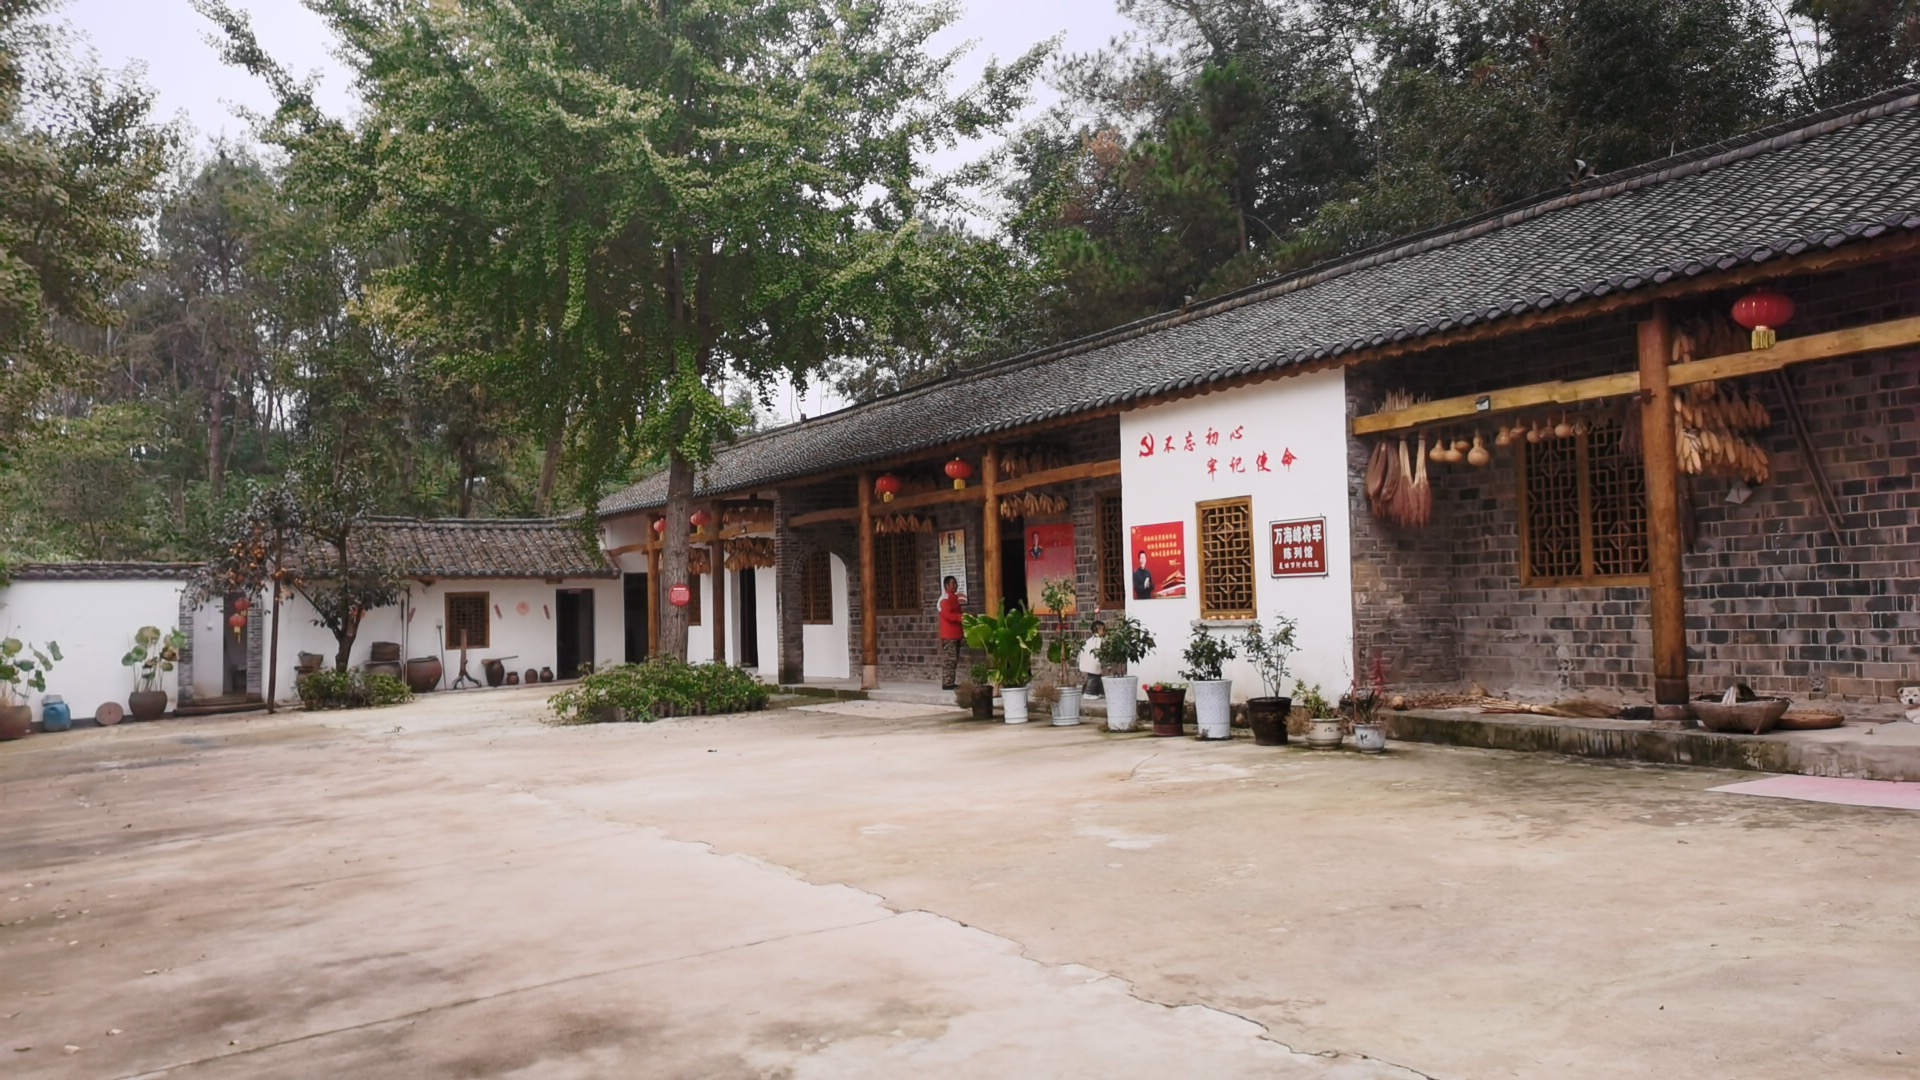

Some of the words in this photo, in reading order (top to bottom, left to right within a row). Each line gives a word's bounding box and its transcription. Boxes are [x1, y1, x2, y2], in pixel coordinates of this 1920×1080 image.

[1164, 425, 1243, 453] 不忘初心
[1207, 447, 1298, 482] 牢记使命
[1274, 524, 1322, 545] 万海峰将军
[1283, 545, 1313, 560] 陈列馆
